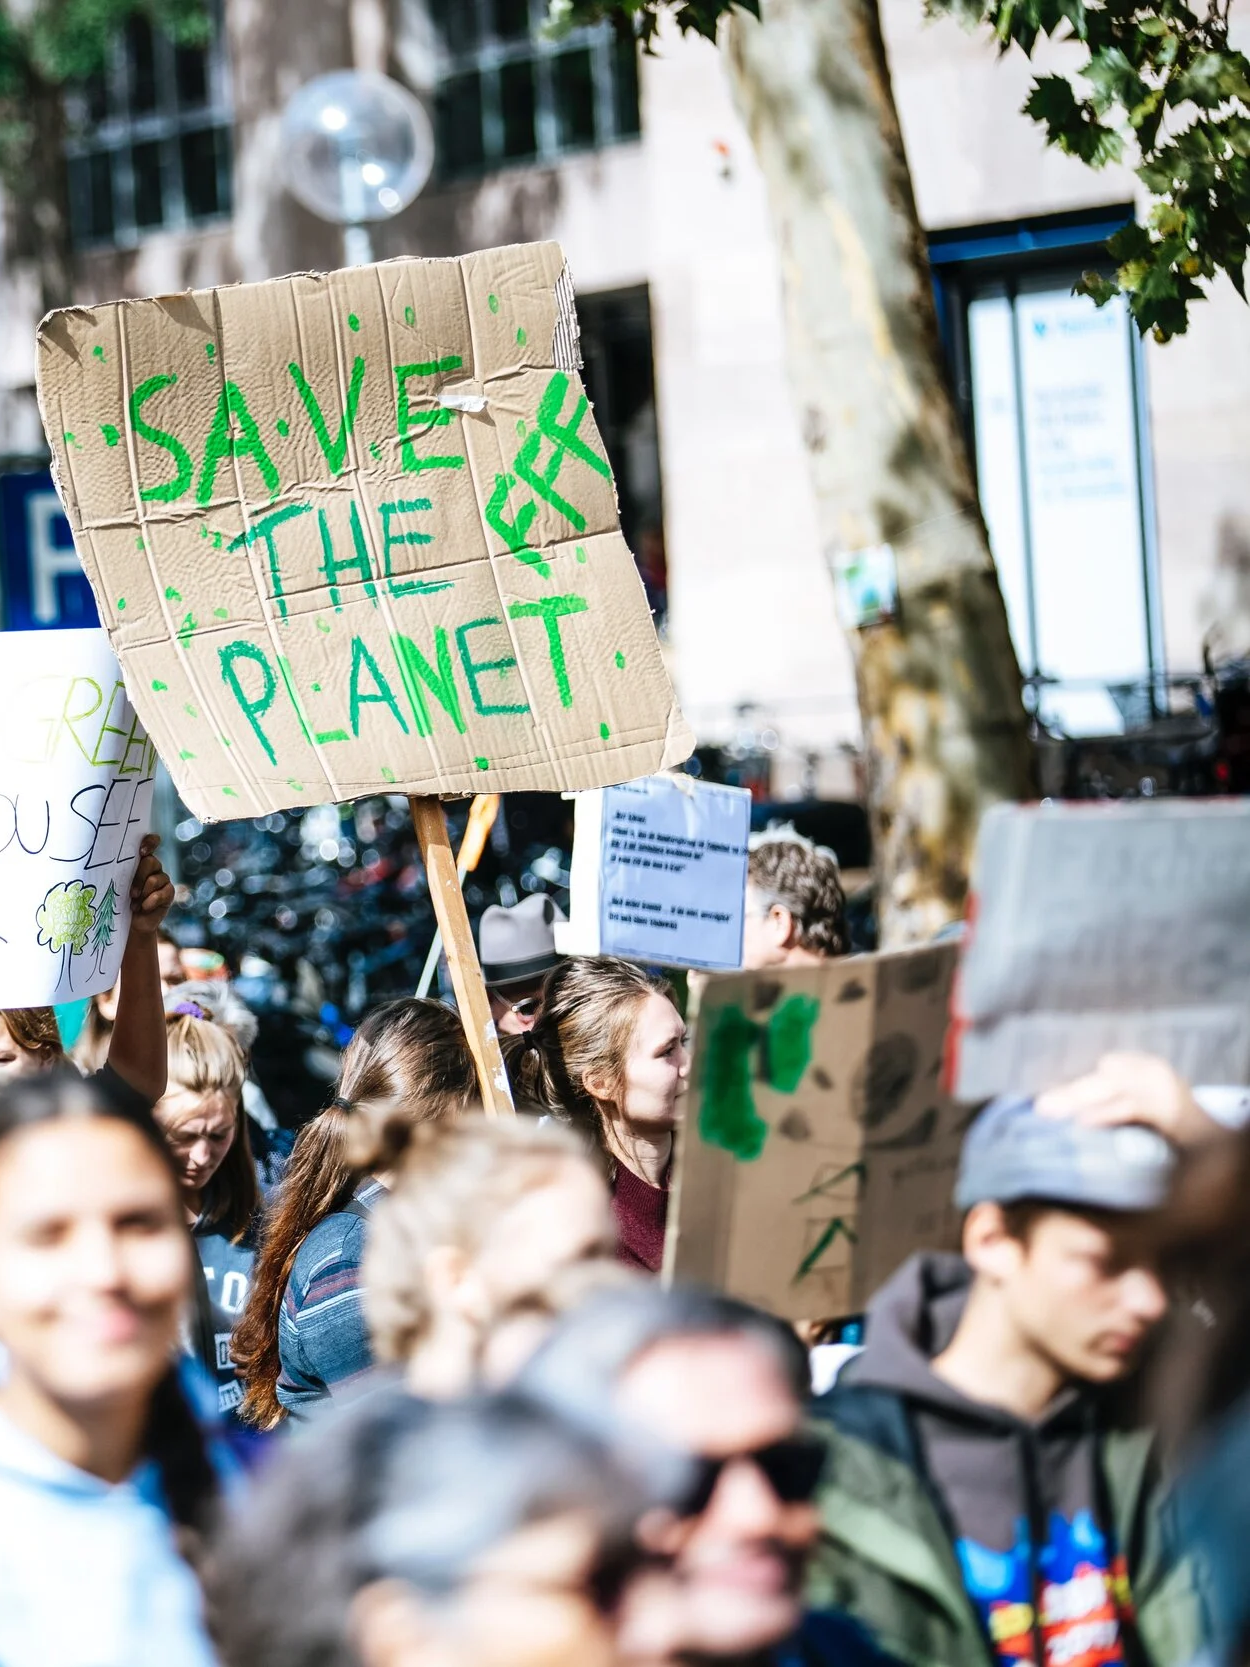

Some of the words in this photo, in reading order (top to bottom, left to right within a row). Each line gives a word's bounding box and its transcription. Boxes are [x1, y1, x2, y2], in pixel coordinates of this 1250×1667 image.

[129, 355, 465, 507] SAVE
[486, 370, 613, 579] FFF
[226, 499, 454, 625] THE
[217, 596, 588, 766] PLANET
[48, 777, 154, 871] SEE
